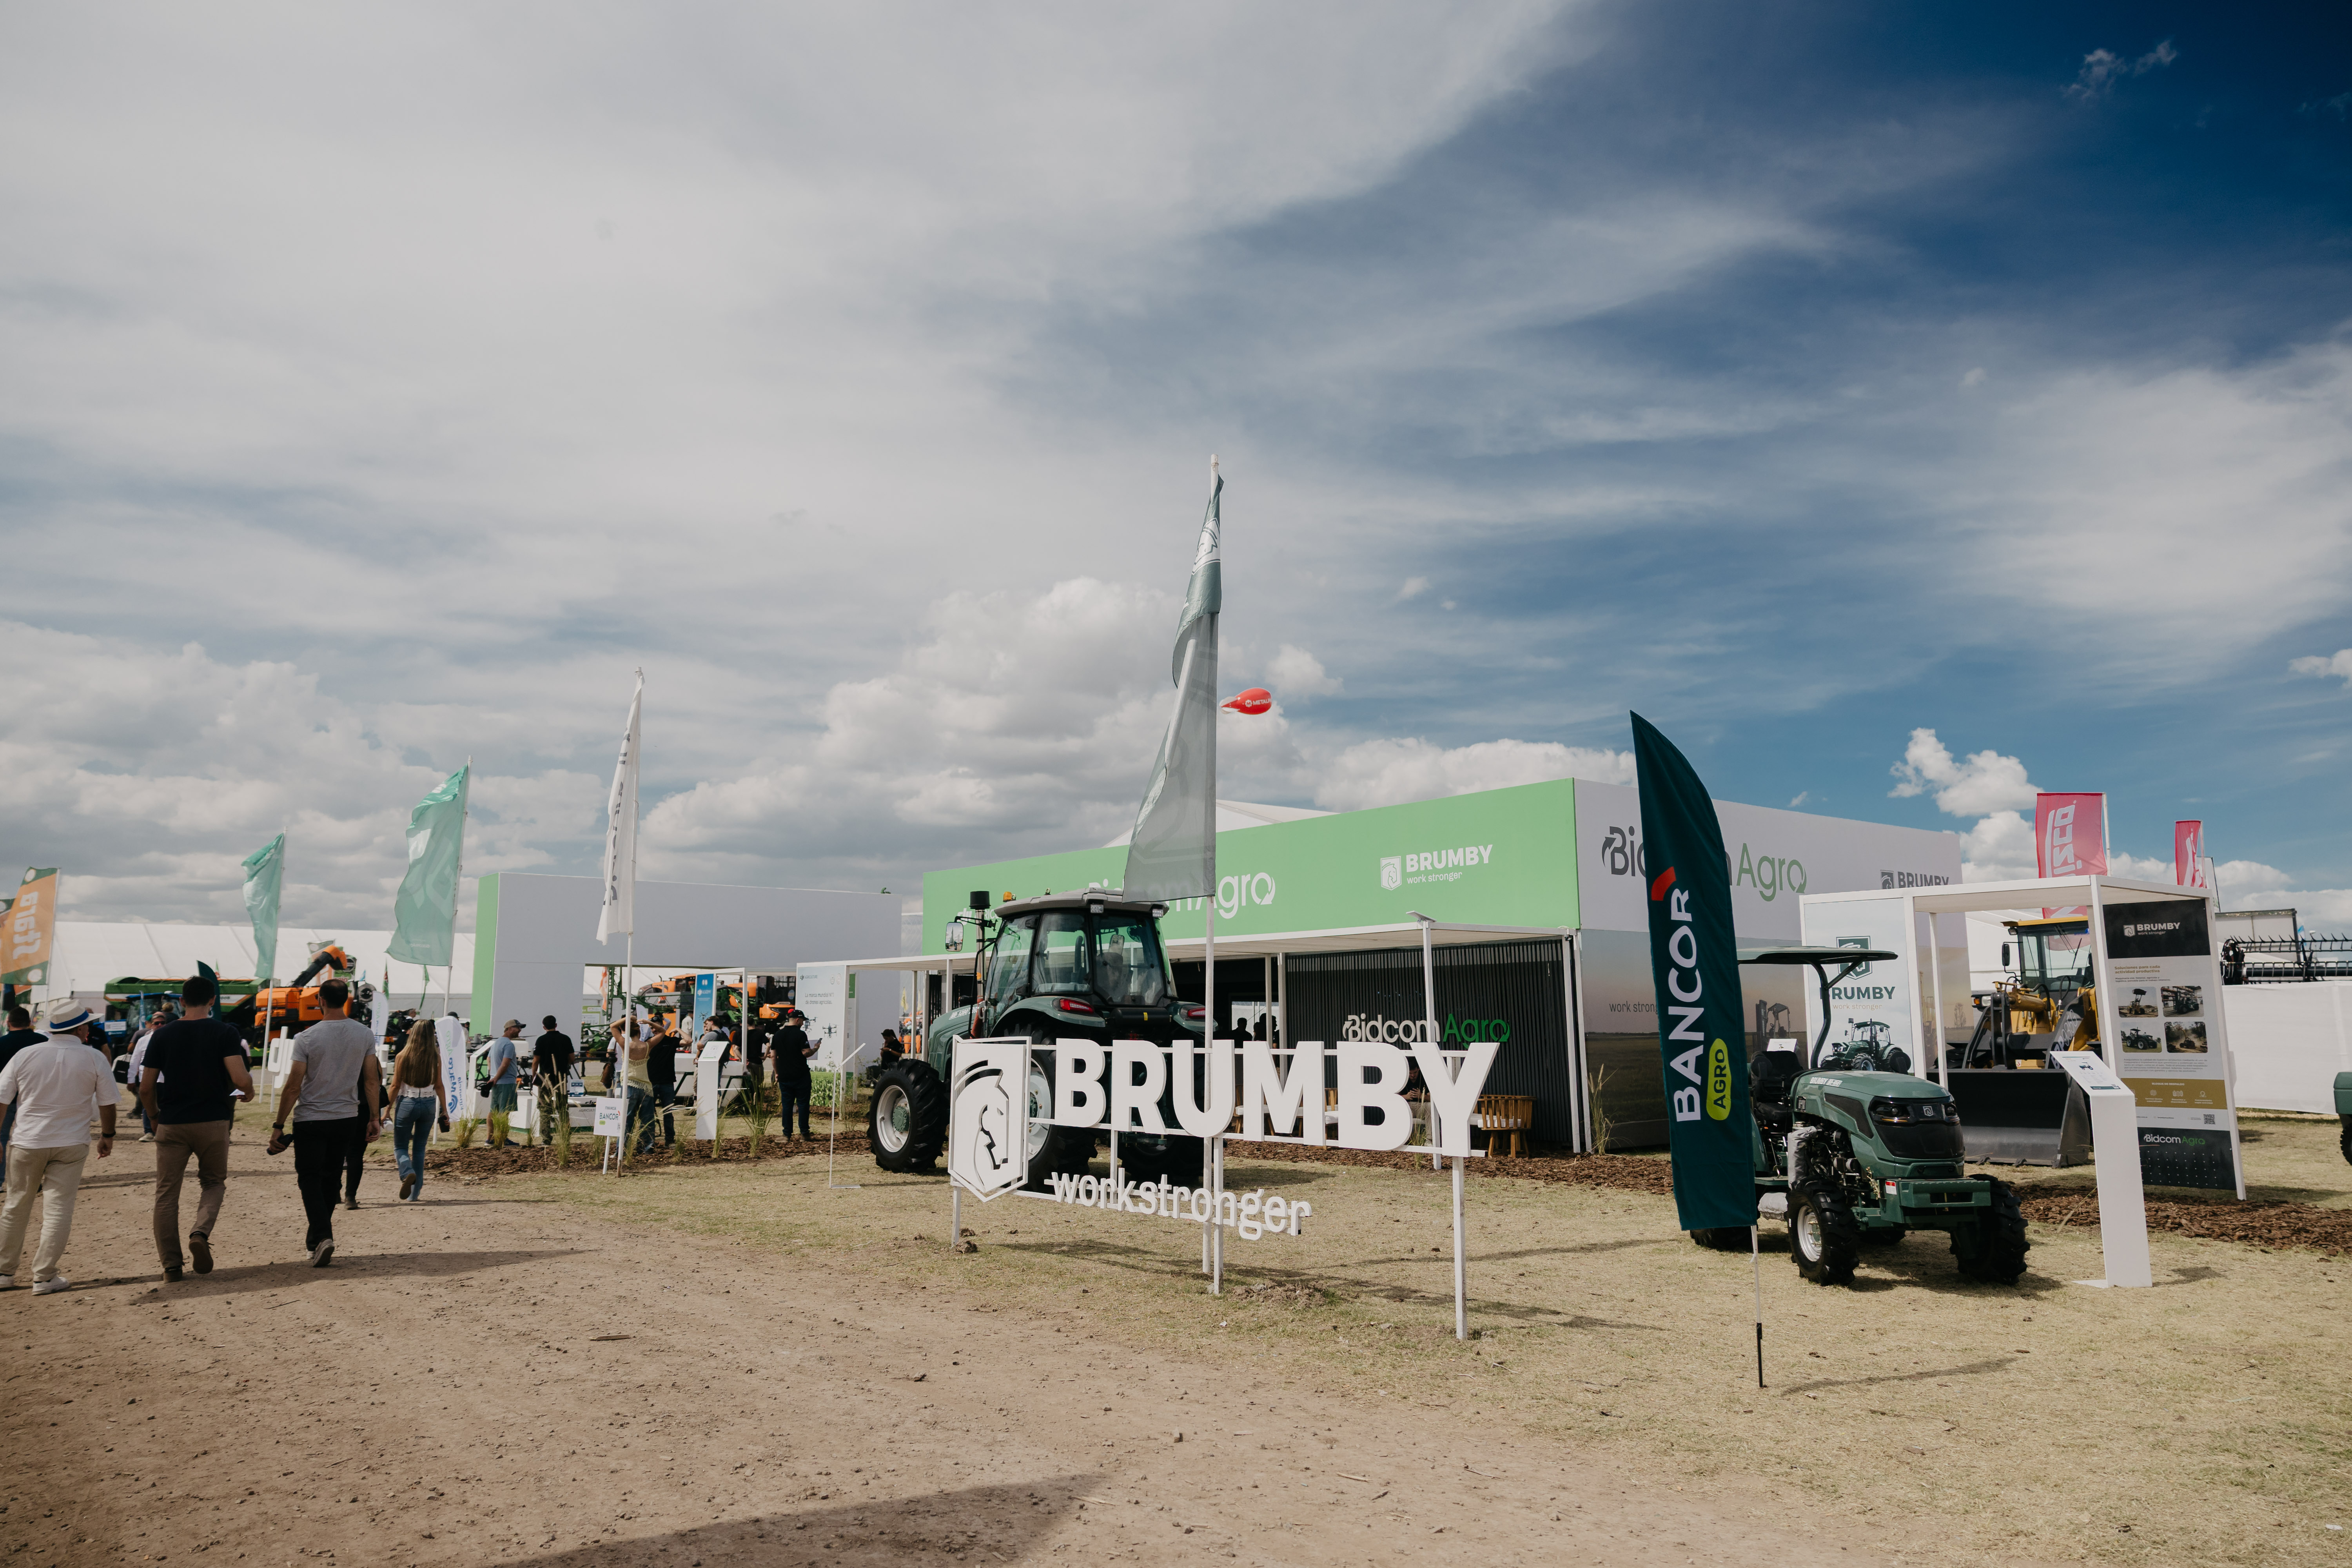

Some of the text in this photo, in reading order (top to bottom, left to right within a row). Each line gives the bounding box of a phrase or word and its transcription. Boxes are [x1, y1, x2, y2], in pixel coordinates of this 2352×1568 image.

[1406, 844, 1493, 872] BRUMBY
[1737, 842, 1807, 902] Agro
[1196, 872, 1276, 919] gro
[1407, 871, 1462, 884] work stronger
[2137, 922, 2181, 931] BRUMBY
[1609, 1000, 1631, 1012] work
[1668, 888, 1704, 1122] BANCOR
[1443, 1013, 1510, 1049] Agro
[1713, 1048, 1726, 1109] AGRO
[1054, 1038, 1500, 1158] BRUMBY
[2143, 1134, 2205, 1146] Bidcom Agro
